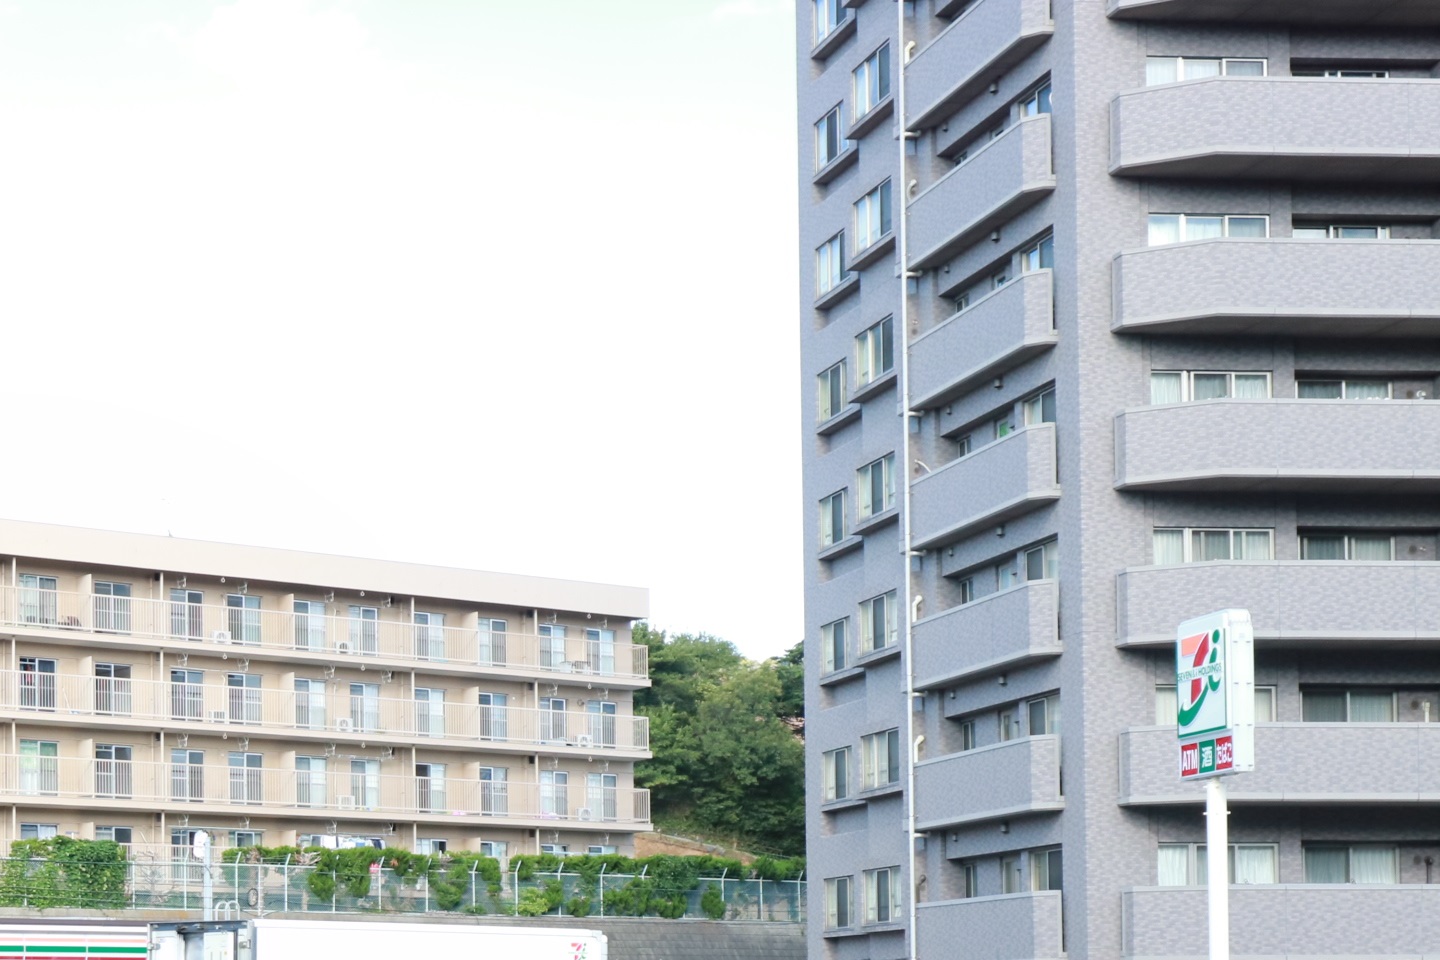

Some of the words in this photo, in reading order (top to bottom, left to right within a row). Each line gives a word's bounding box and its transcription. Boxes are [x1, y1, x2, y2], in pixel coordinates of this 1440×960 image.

[1182, 749, 1198, 771] ATM
[1201, 745, 1213, 769] 酒
[1216, 742, 1232, 764] たばこ
